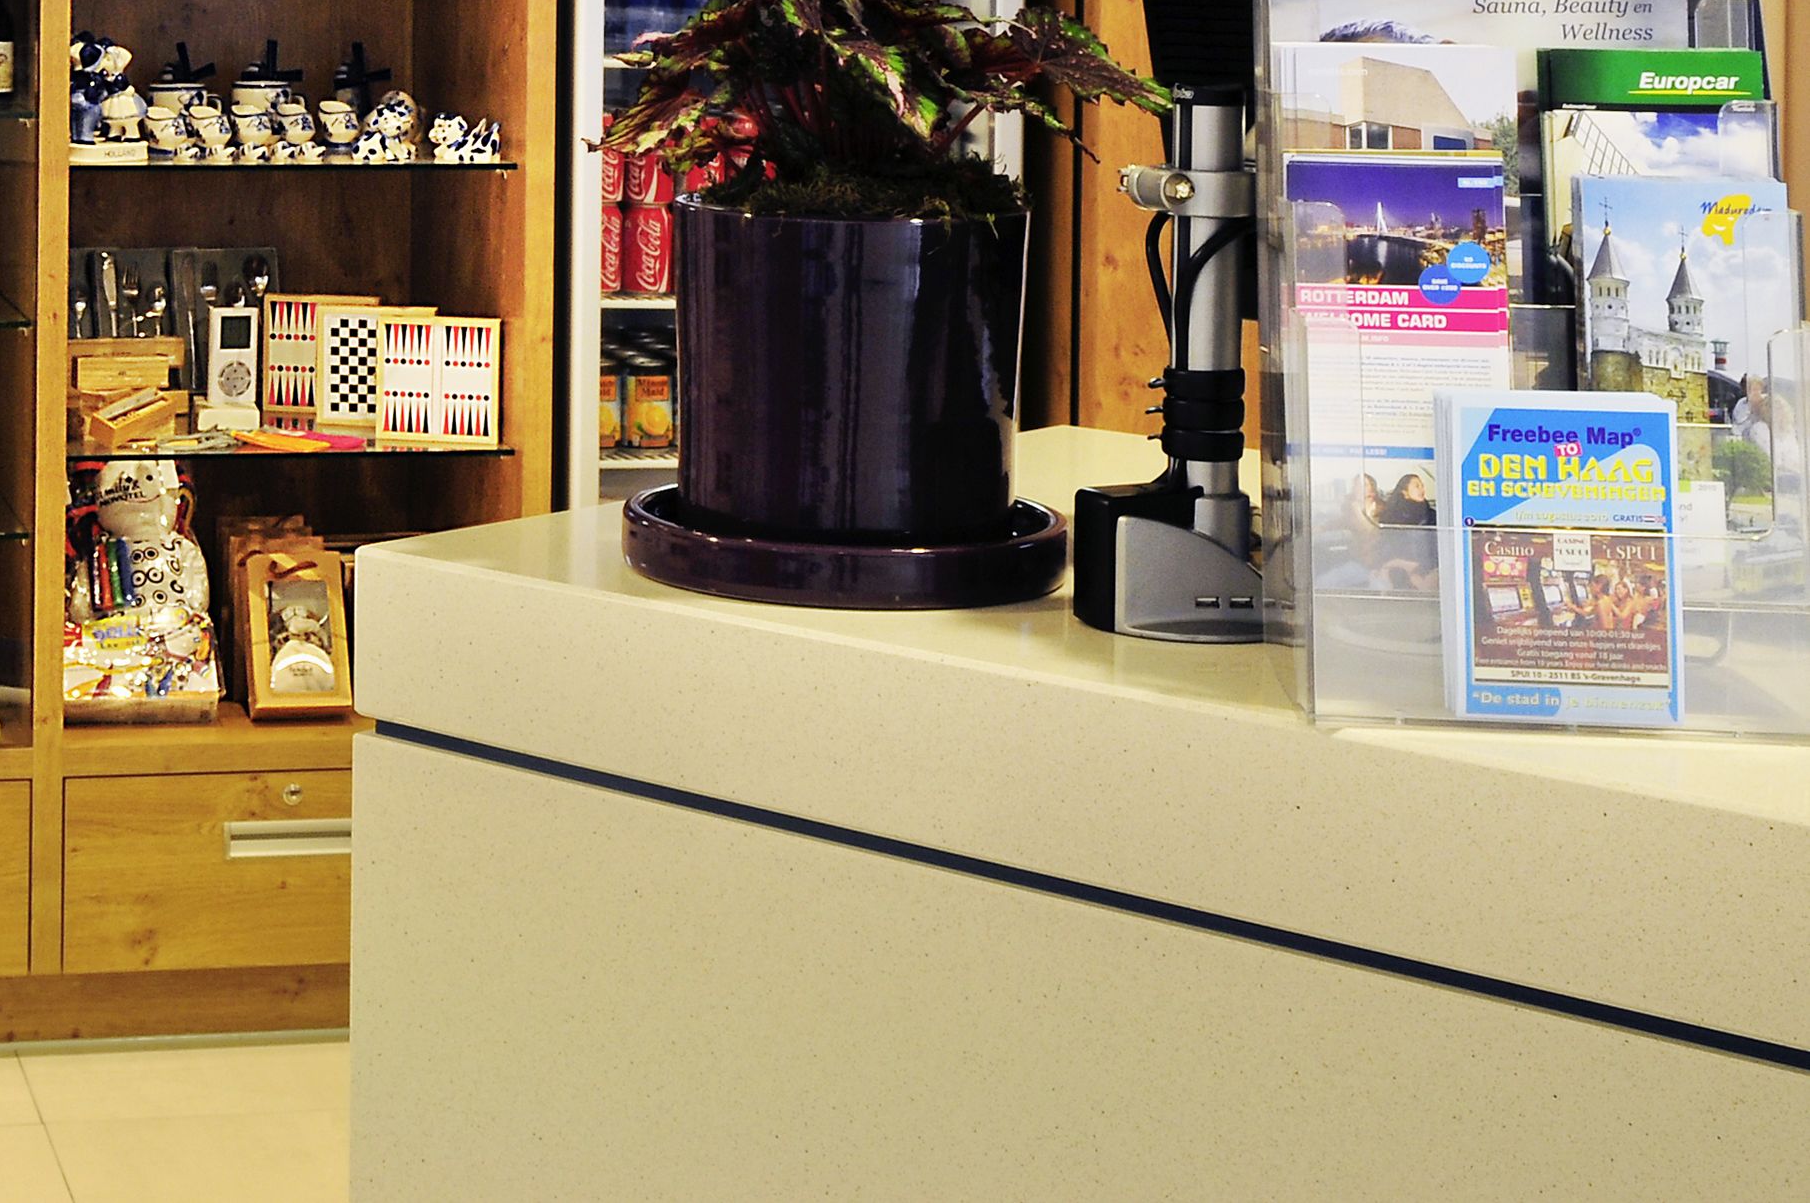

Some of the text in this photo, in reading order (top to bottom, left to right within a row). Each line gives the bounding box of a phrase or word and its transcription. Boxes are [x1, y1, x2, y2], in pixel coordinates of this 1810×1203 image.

[1633, 1, 1653, 14] en
[1561, 21, 1654, 41] Wellness
[1638, 71, 1740, 95] Europcar
[104, 148, 137, 158] HOLLAND
[1300, 288, 1410, 306] ROTTERDAM
[1397, 314, 1448, 329] CARD
[1488, 424, 1579, 444] Freebee
[1556, 443, 1578, 455] TO
[1479, 453, 1655, 483] DEN HAAG
[1467, 480, 1666, 502] EN SCHEVENINGEN
[1613, 514, 1644, 523] GRATIS
[1484, 540, 1535, 557] Casino
[1615, 544, 1656, 560] SPUI
[1511, 670, 1531, 678] SPUI
[1548, 671, 1569, 680] 2511
[1507, 693, 1540, 705] stad
[1545, 694, 1560, 706] in
